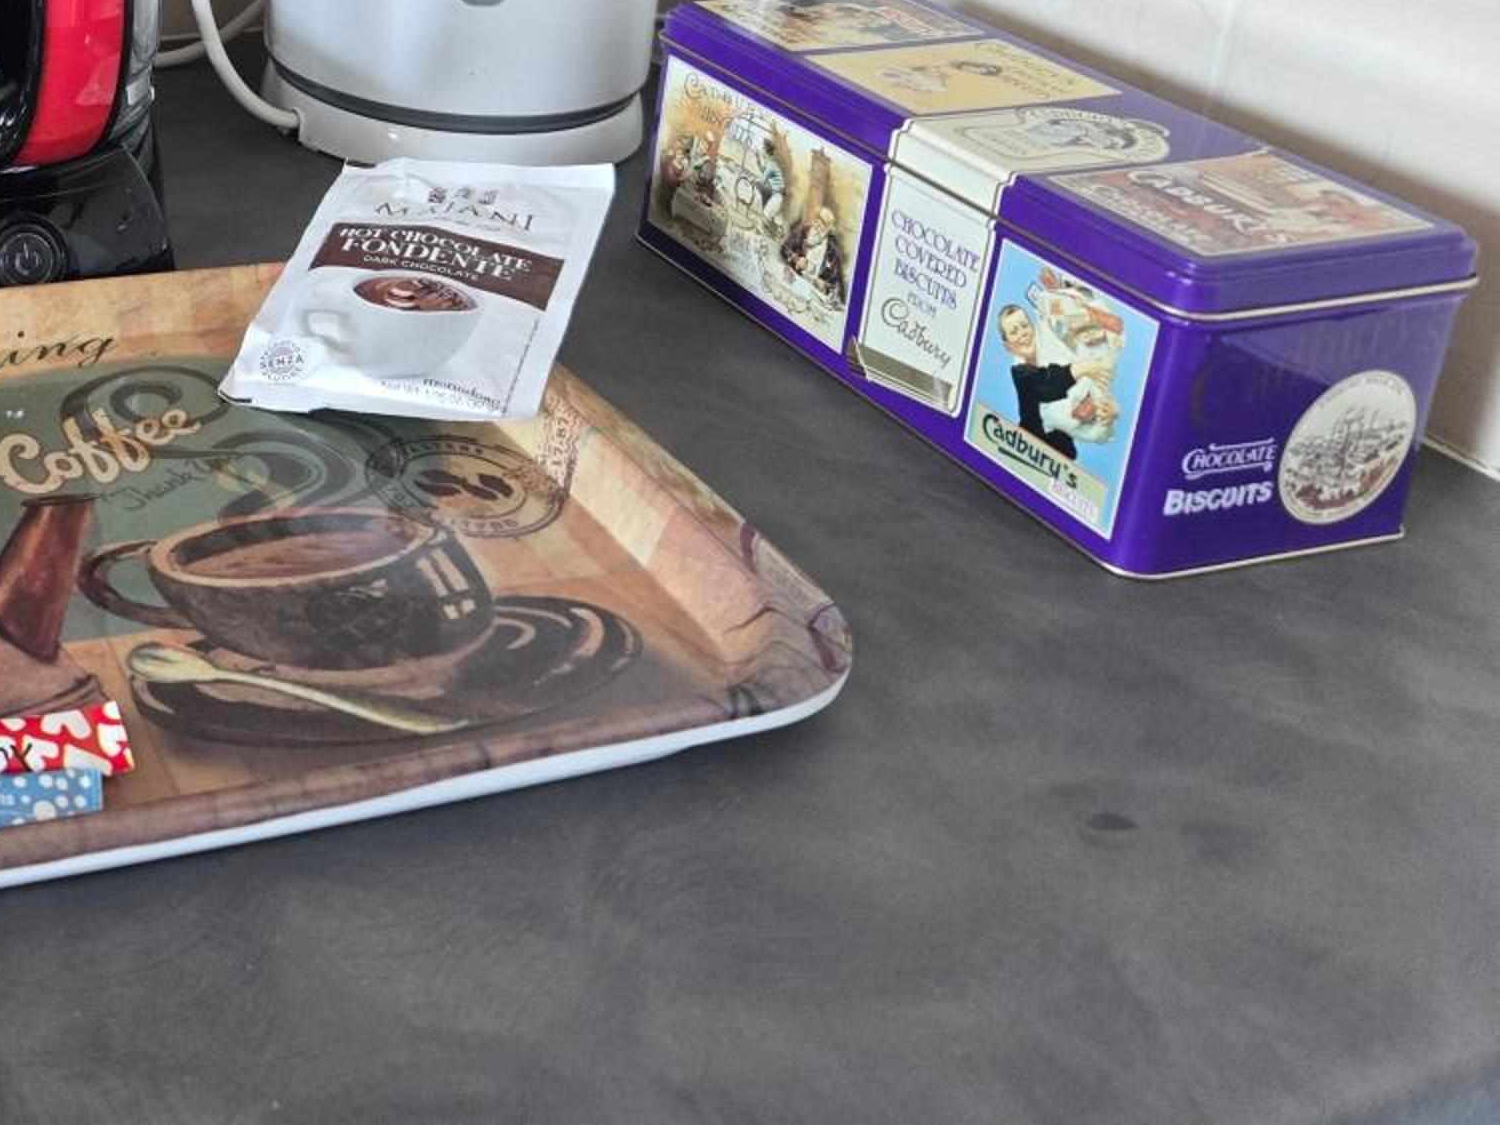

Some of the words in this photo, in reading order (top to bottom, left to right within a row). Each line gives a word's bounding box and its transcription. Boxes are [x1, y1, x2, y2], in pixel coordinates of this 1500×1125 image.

[339, 226, 389, 240] HOT
[391, 229, 533, 273] CHOCOLATE
[339, 237, 513, 281] FONDENTE
[891, 210, 981, 273] CHOCOLATE
[894, 235, 967, 289] COVERED
[362, 254, 399, 267] DARK
[400, 259, 481, 282] CHOCOLATE
[893, 260, 958, 310] BISCUITS
[906, 291, 937, 319] FROM
[881, 297, 952, 368] Cadbury
[259, 353, 305, 371] SENZA
[982, 413, 1078, 489] Cadbury's
[1181, 439, 1278, 479] CHOCOLATE
[1163, 480, 1273, 516] BISCUITS
